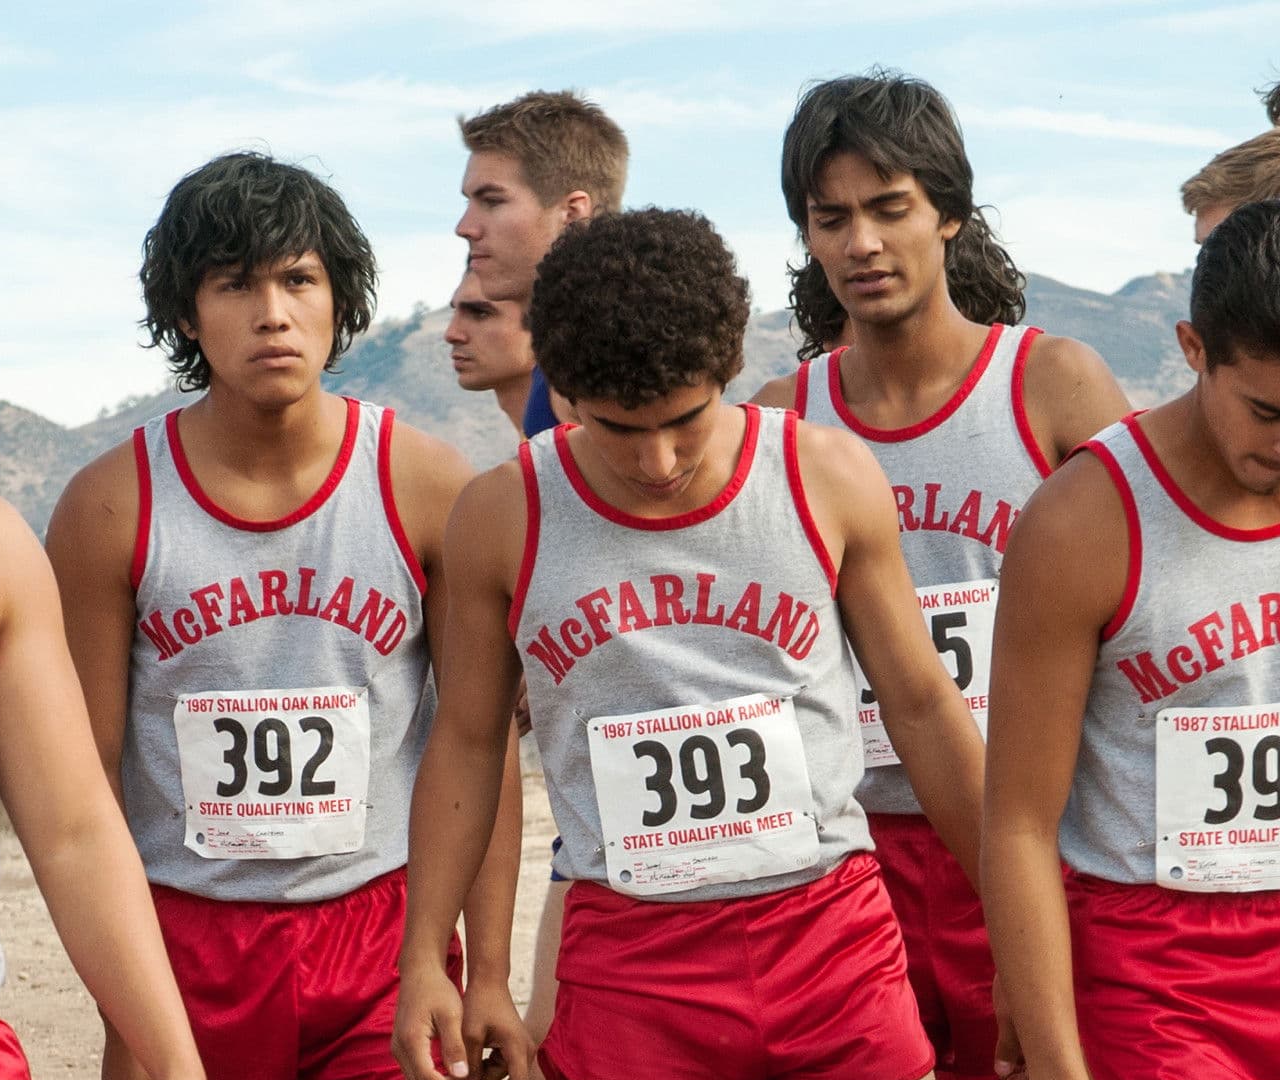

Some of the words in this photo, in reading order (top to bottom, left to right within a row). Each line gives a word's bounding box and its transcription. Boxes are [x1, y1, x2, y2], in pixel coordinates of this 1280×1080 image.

[916, 594, 940, 610] AK
[943, 589, 990, 606] RANCH
[139, 567, 407, 661] McFARLAND
[526, 573, 820, 686] McFARLAND
[186, 698, 214, 712] 1987
[216, 698, 279, 713] STALLION
[282, 697, 309, 711] OAK
[312, 694, 356, 710] RANCH
[965, 696, 987, 710] EE
[602, 722, 633, 739] 1987
[636, 714, 703, 736] STALLION
[706, 708, 736, 726] OAK
[738, 699, 781, 720] RANCH
[858, 709, 876, 723] ATE
[1173, 716, 1209, 732] 1987
[1212, 713, 1280, 732] STALLION
[213, 716, 337, 798] 392
[632, 728, 772, 827] 393
[199, 802, 232, 816] STATE
[236, 801, 315, 817] QUALIFYING
[318, 799, 351, 814] MEET
[624, 832, 664, 850] STATE
[667, 820, 753, 846] QUALIFYING
[756, 811, 793, 831] MEET
[1179, 830, 1223, 847] STATE
